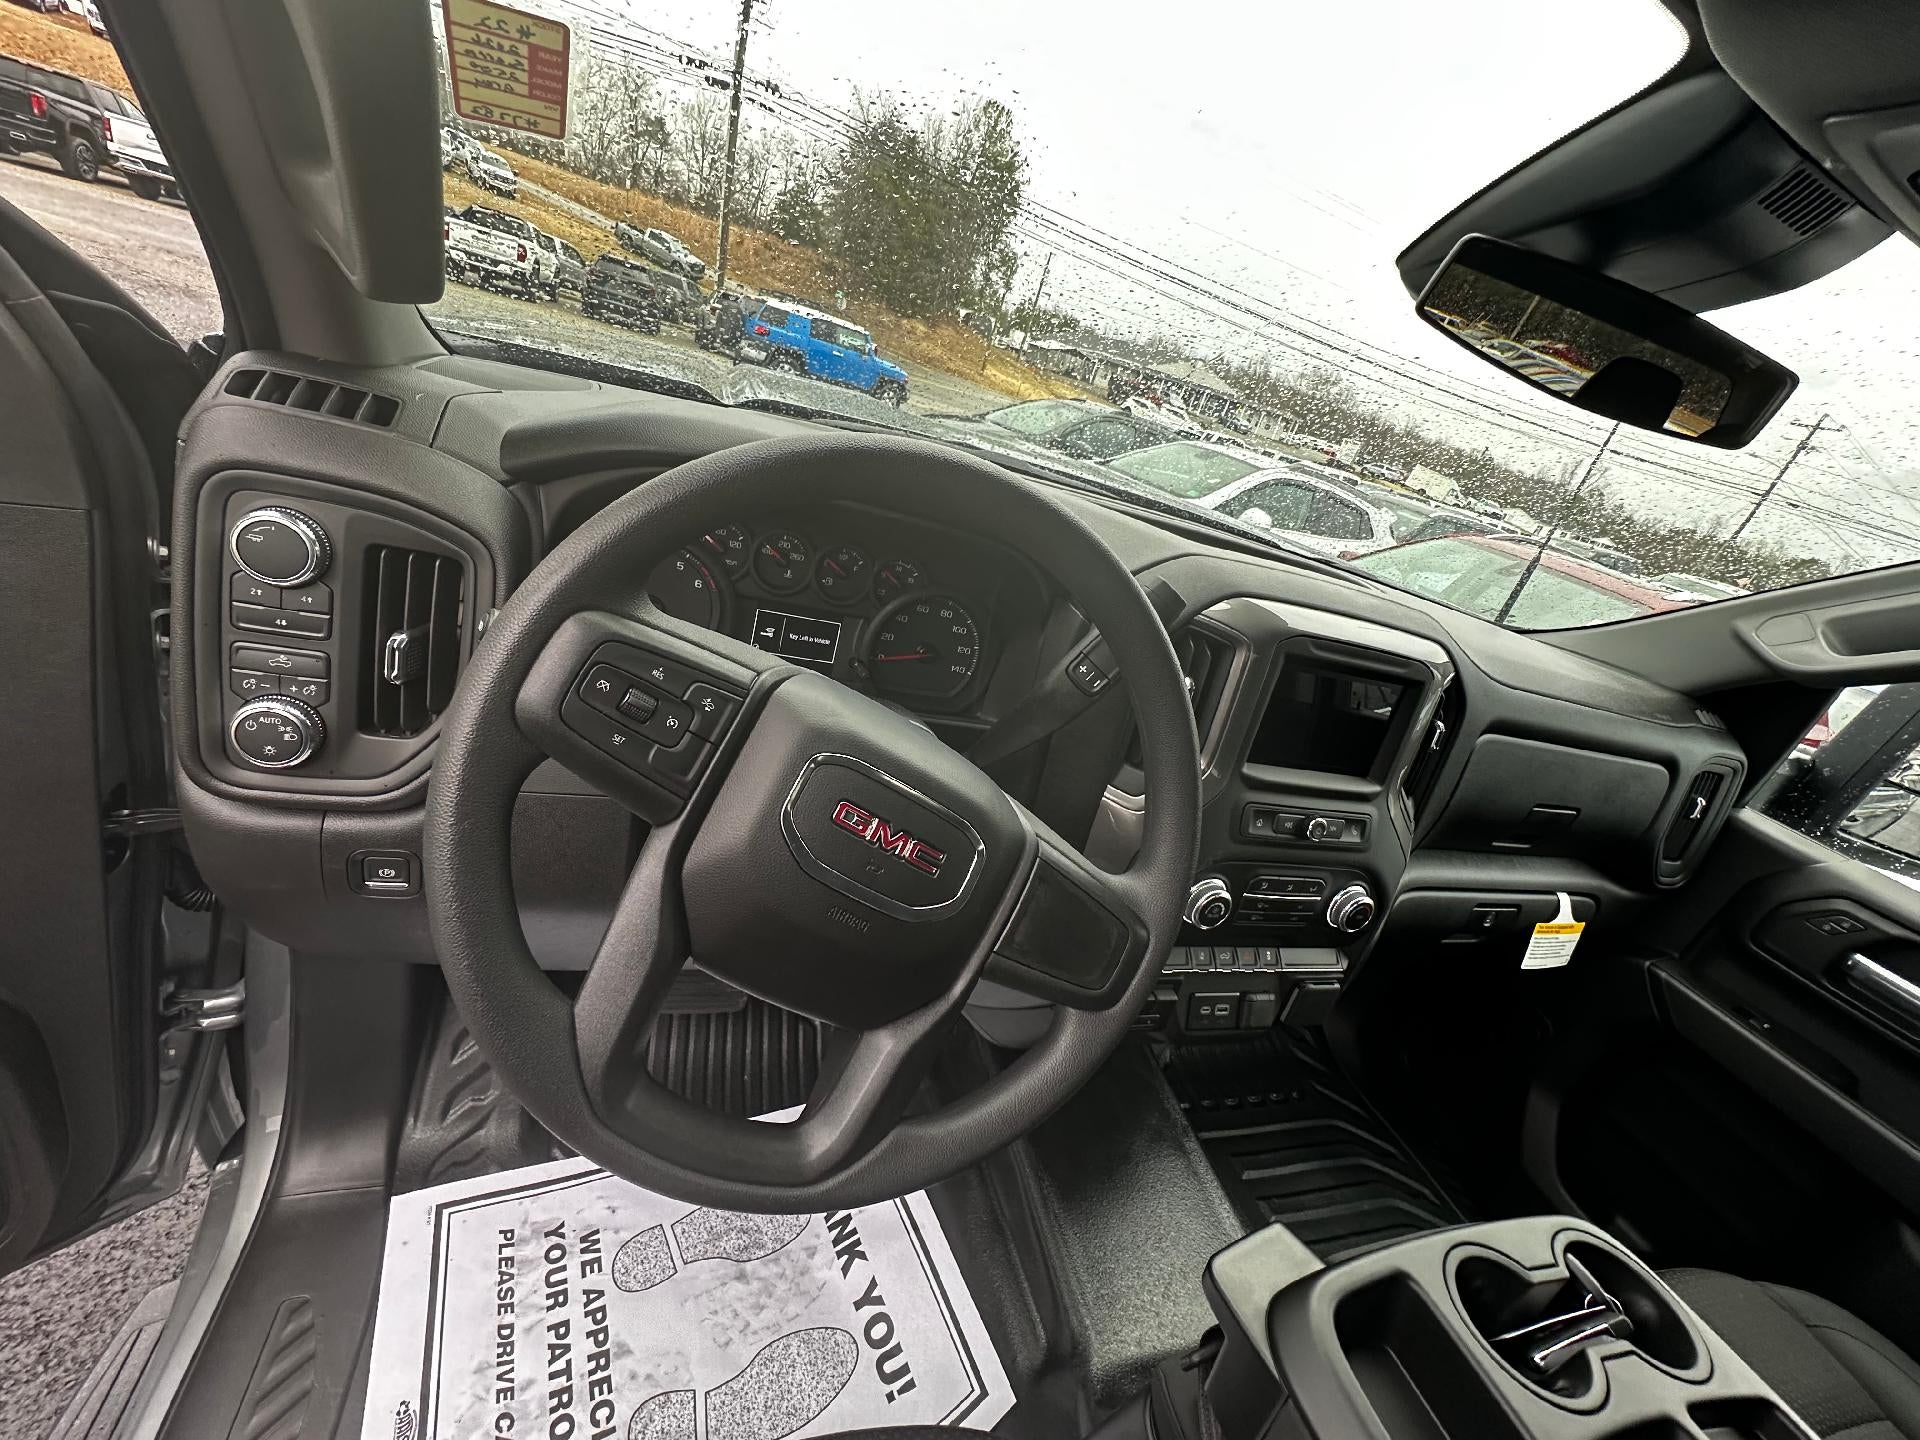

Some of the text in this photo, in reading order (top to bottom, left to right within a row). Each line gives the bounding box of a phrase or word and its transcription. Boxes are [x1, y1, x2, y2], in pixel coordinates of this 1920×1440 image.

[676, 562, 685, 571] 5
[694, 579, 703, 589] 6
[916, 605, 930, 613] 60
[940, 609, 953, 619] 80
[896, 615, 909, 623] 40
[952, 625, 967, 635] 100
[789, 633, 799, 641] Key
[799, 634, 809, 642] Left
[814, 637, 831, 645] Vehicle
[881, 632, 894, 641] 20
[957, 645, 971, 655] 120
[951, 665, 966, 674] 140
[651, 669, 665, 681] RES
[258, 716, 282, 726] AUTO
[611, 734, 626, 744] SET
[832, 800, 947, 878] GMC
[579, 1228, 603, 1279] WE
[544, 1219, 569, 1313] YOUR
[494, 1228, 515, 1440] PLEASE DRIVE C
[852, 1274, 918, 1405] YOU!
